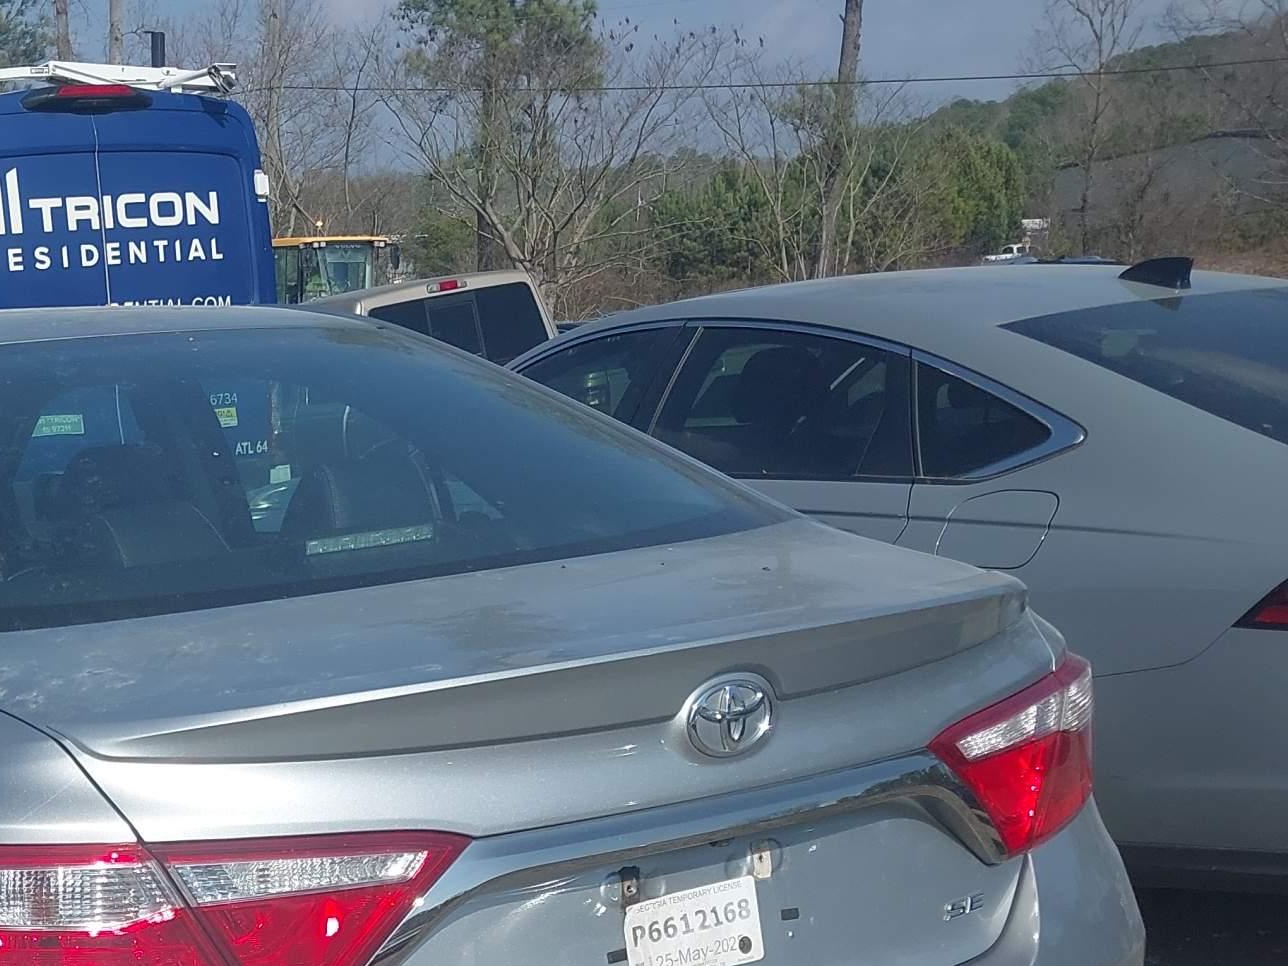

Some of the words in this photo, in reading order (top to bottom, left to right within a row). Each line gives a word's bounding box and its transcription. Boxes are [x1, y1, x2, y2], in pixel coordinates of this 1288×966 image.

[28, 191, 220, 233] TRICON
[210, 392, 238, 405] 6734
[235, 441, 254, 455] ATL
[256, 440, 268, 453] 64
[631, 898, 752, 948] P6612168
